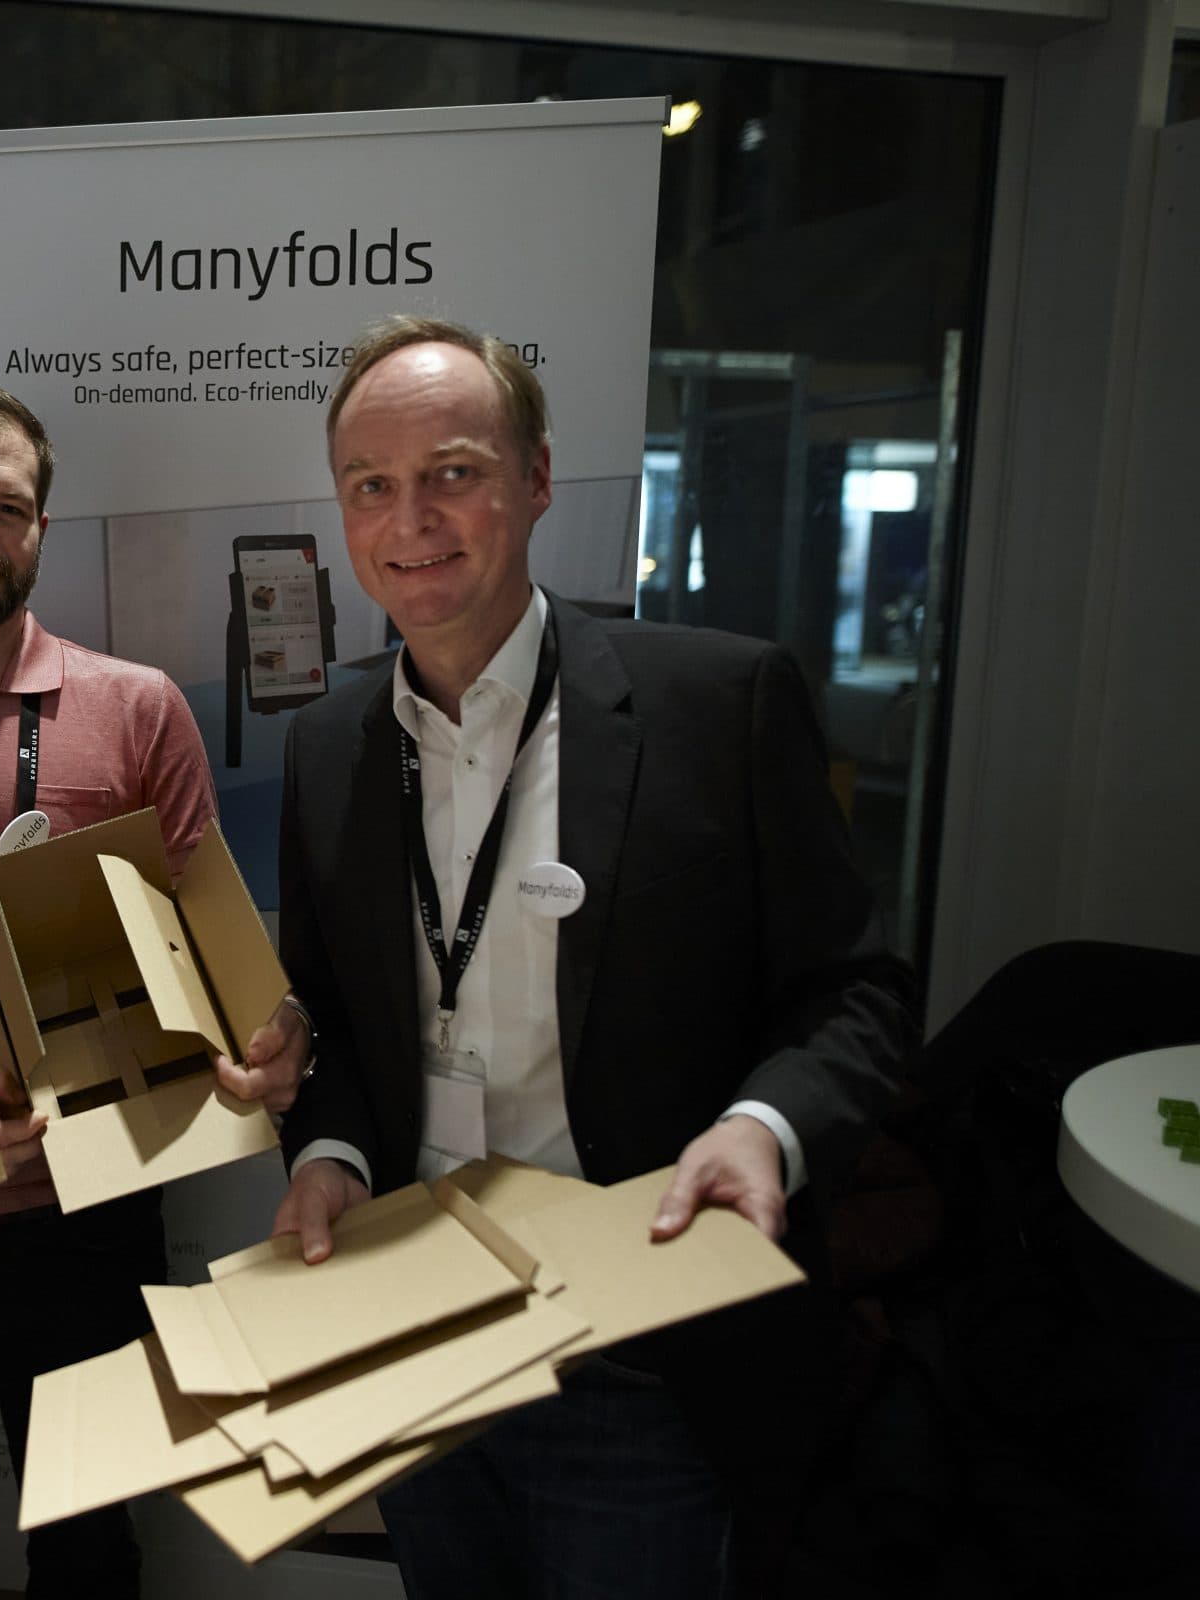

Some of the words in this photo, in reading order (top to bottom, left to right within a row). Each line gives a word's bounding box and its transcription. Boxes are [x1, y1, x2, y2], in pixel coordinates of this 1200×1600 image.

[120, 227, 434, 301] Manyfolds
[5, 346, 102, 378] Always
[111, 344, 178, 374] safe,
[74, 382, 197, 404] On-demand.
[517, 881, 580, 899] Manyfolds
